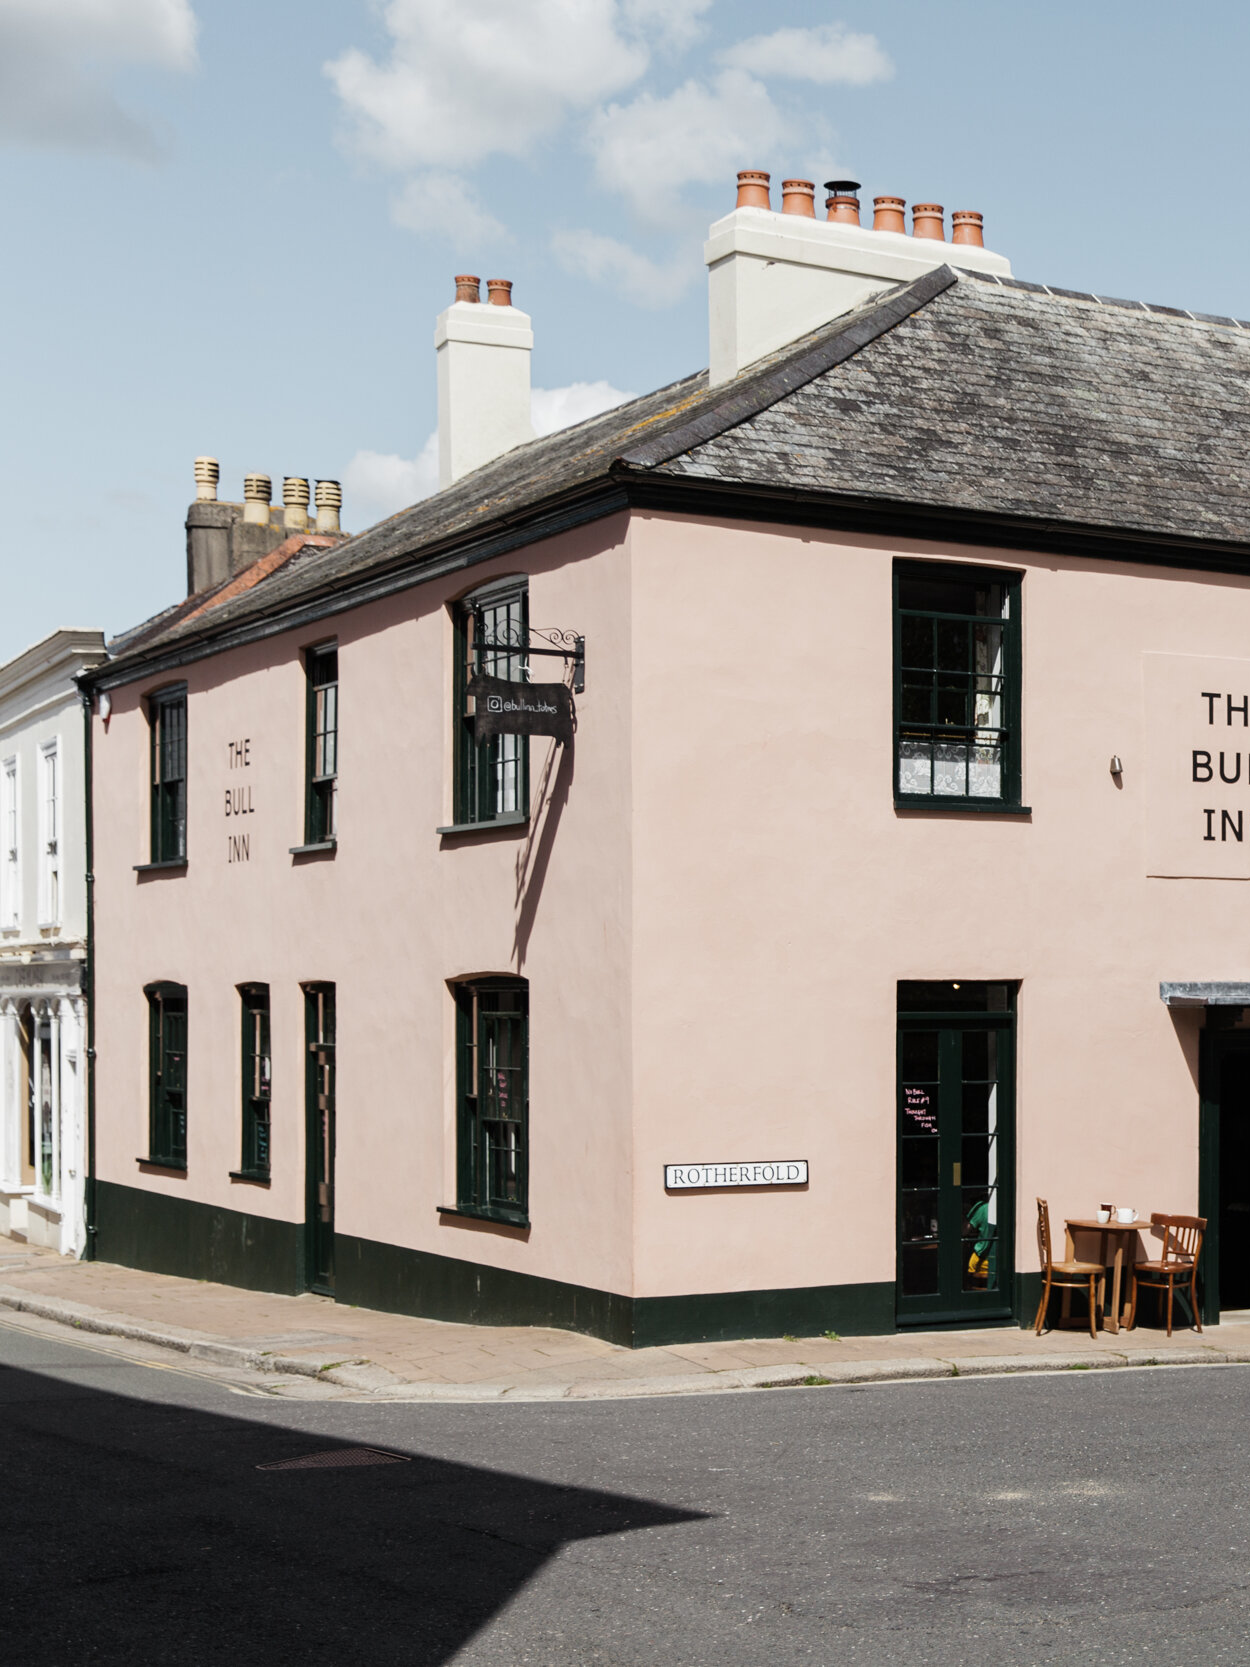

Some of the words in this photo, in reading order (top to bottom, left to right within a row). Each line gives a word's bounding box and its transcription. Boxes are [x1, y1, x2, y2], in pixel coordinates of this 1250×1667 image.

[228, 738, 250, 770] THE
[225, 785, 255, 817] BULL
[228, 833, 250, 863] INN
[674, 1165, 799, 1184] ROTHERFOLD
